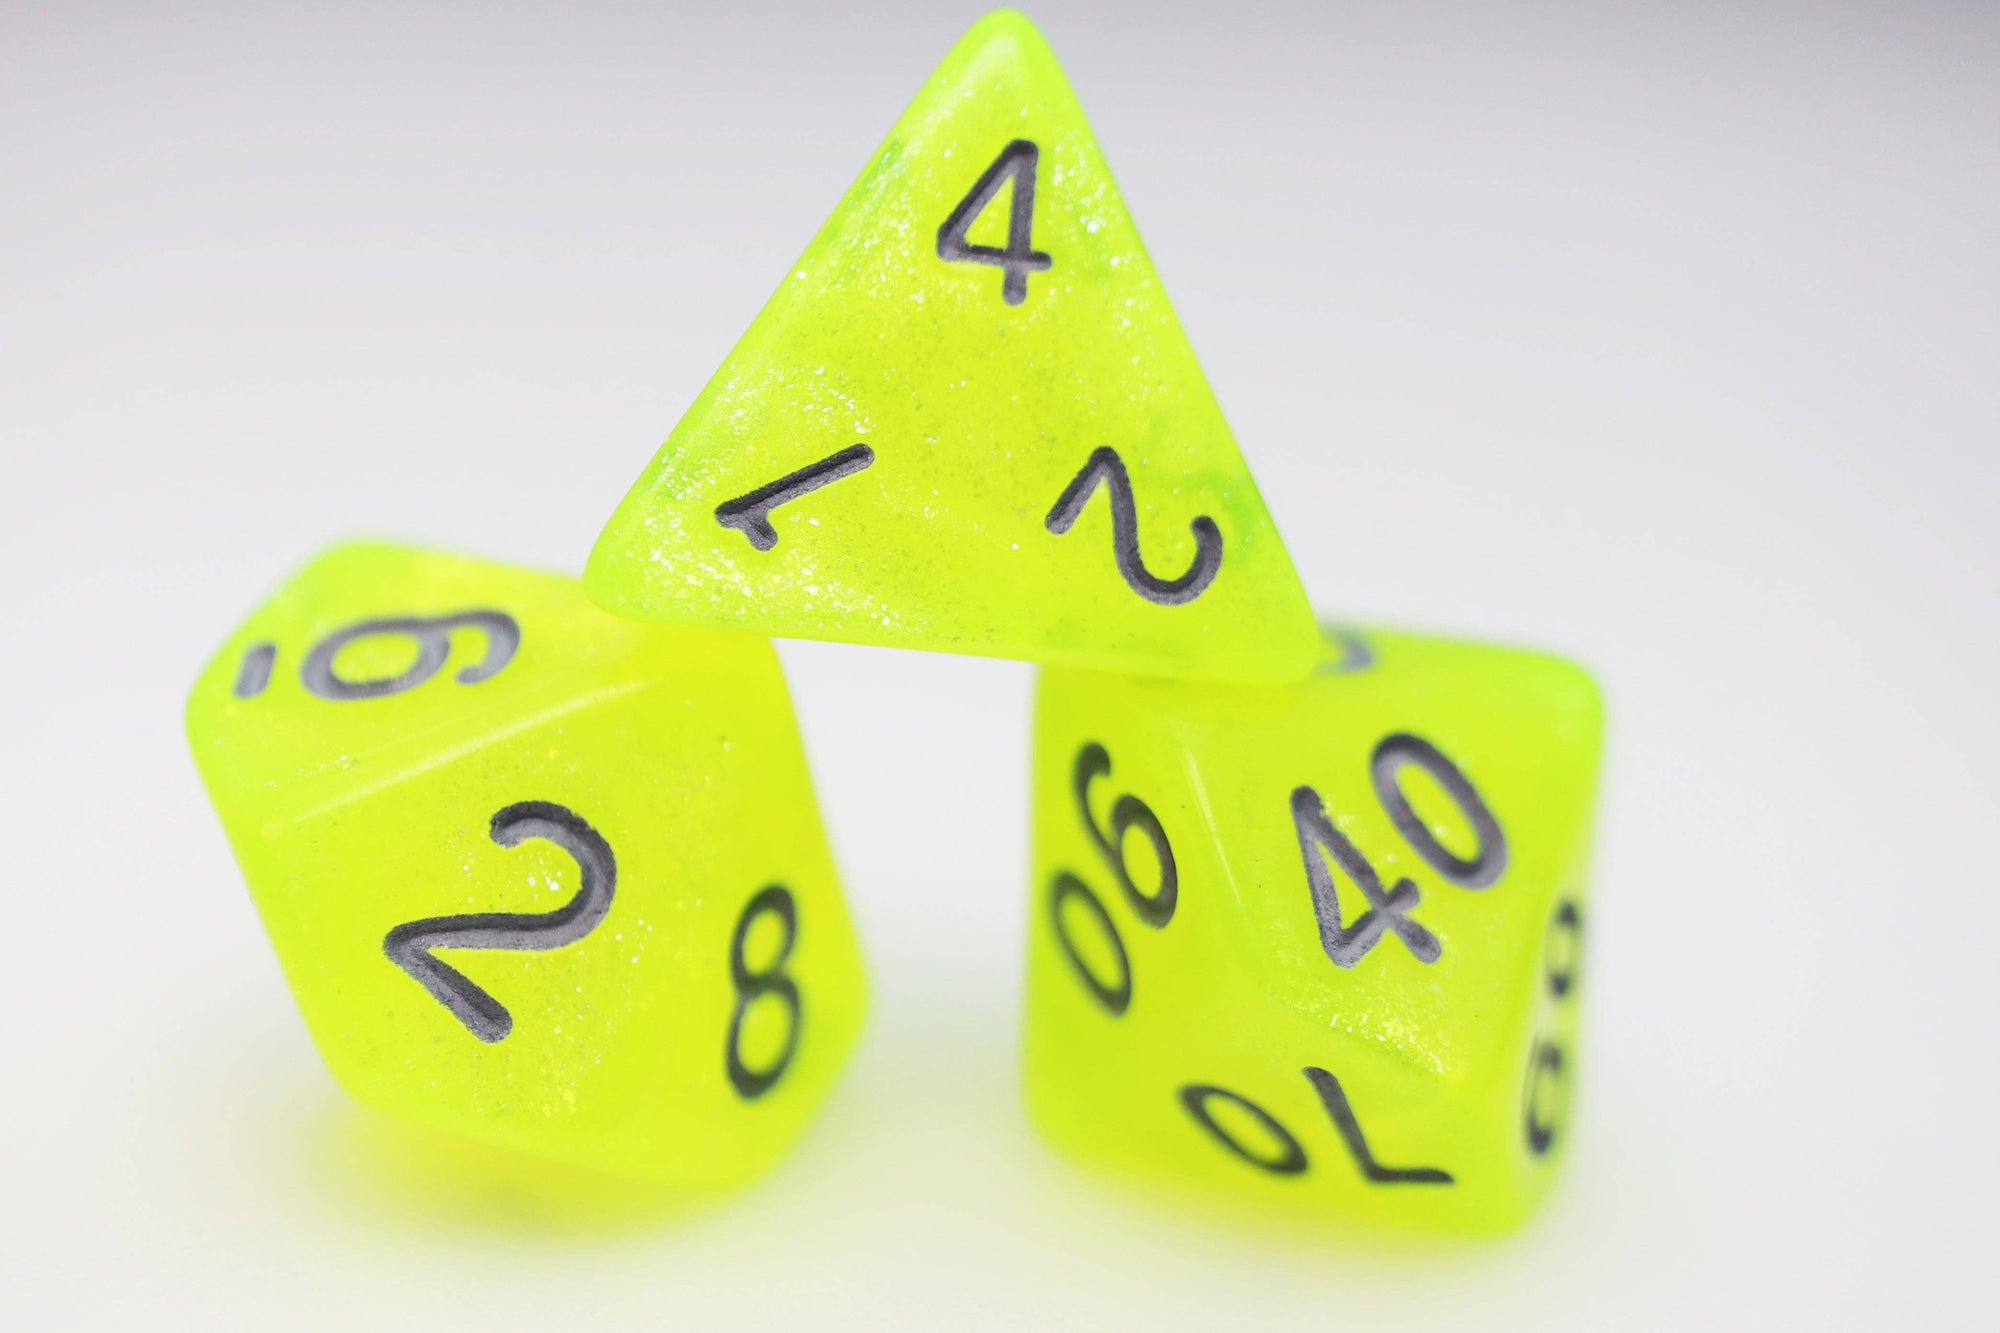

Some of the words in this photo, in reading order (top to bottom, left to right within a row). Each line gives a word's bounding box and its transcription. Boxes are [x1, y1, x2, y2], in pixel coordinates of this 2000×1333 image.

[936, 138, 1053, 305] 4
[714, 442, 875, 552] 1
[1045, 445, 1224, 606] 2
[382, 800, 617, 1043] 2
[1289, 731, 1508, 967] 40
[725, 883, 802, 1101] 8
[1178, 1065, 1456, 1186] 70
